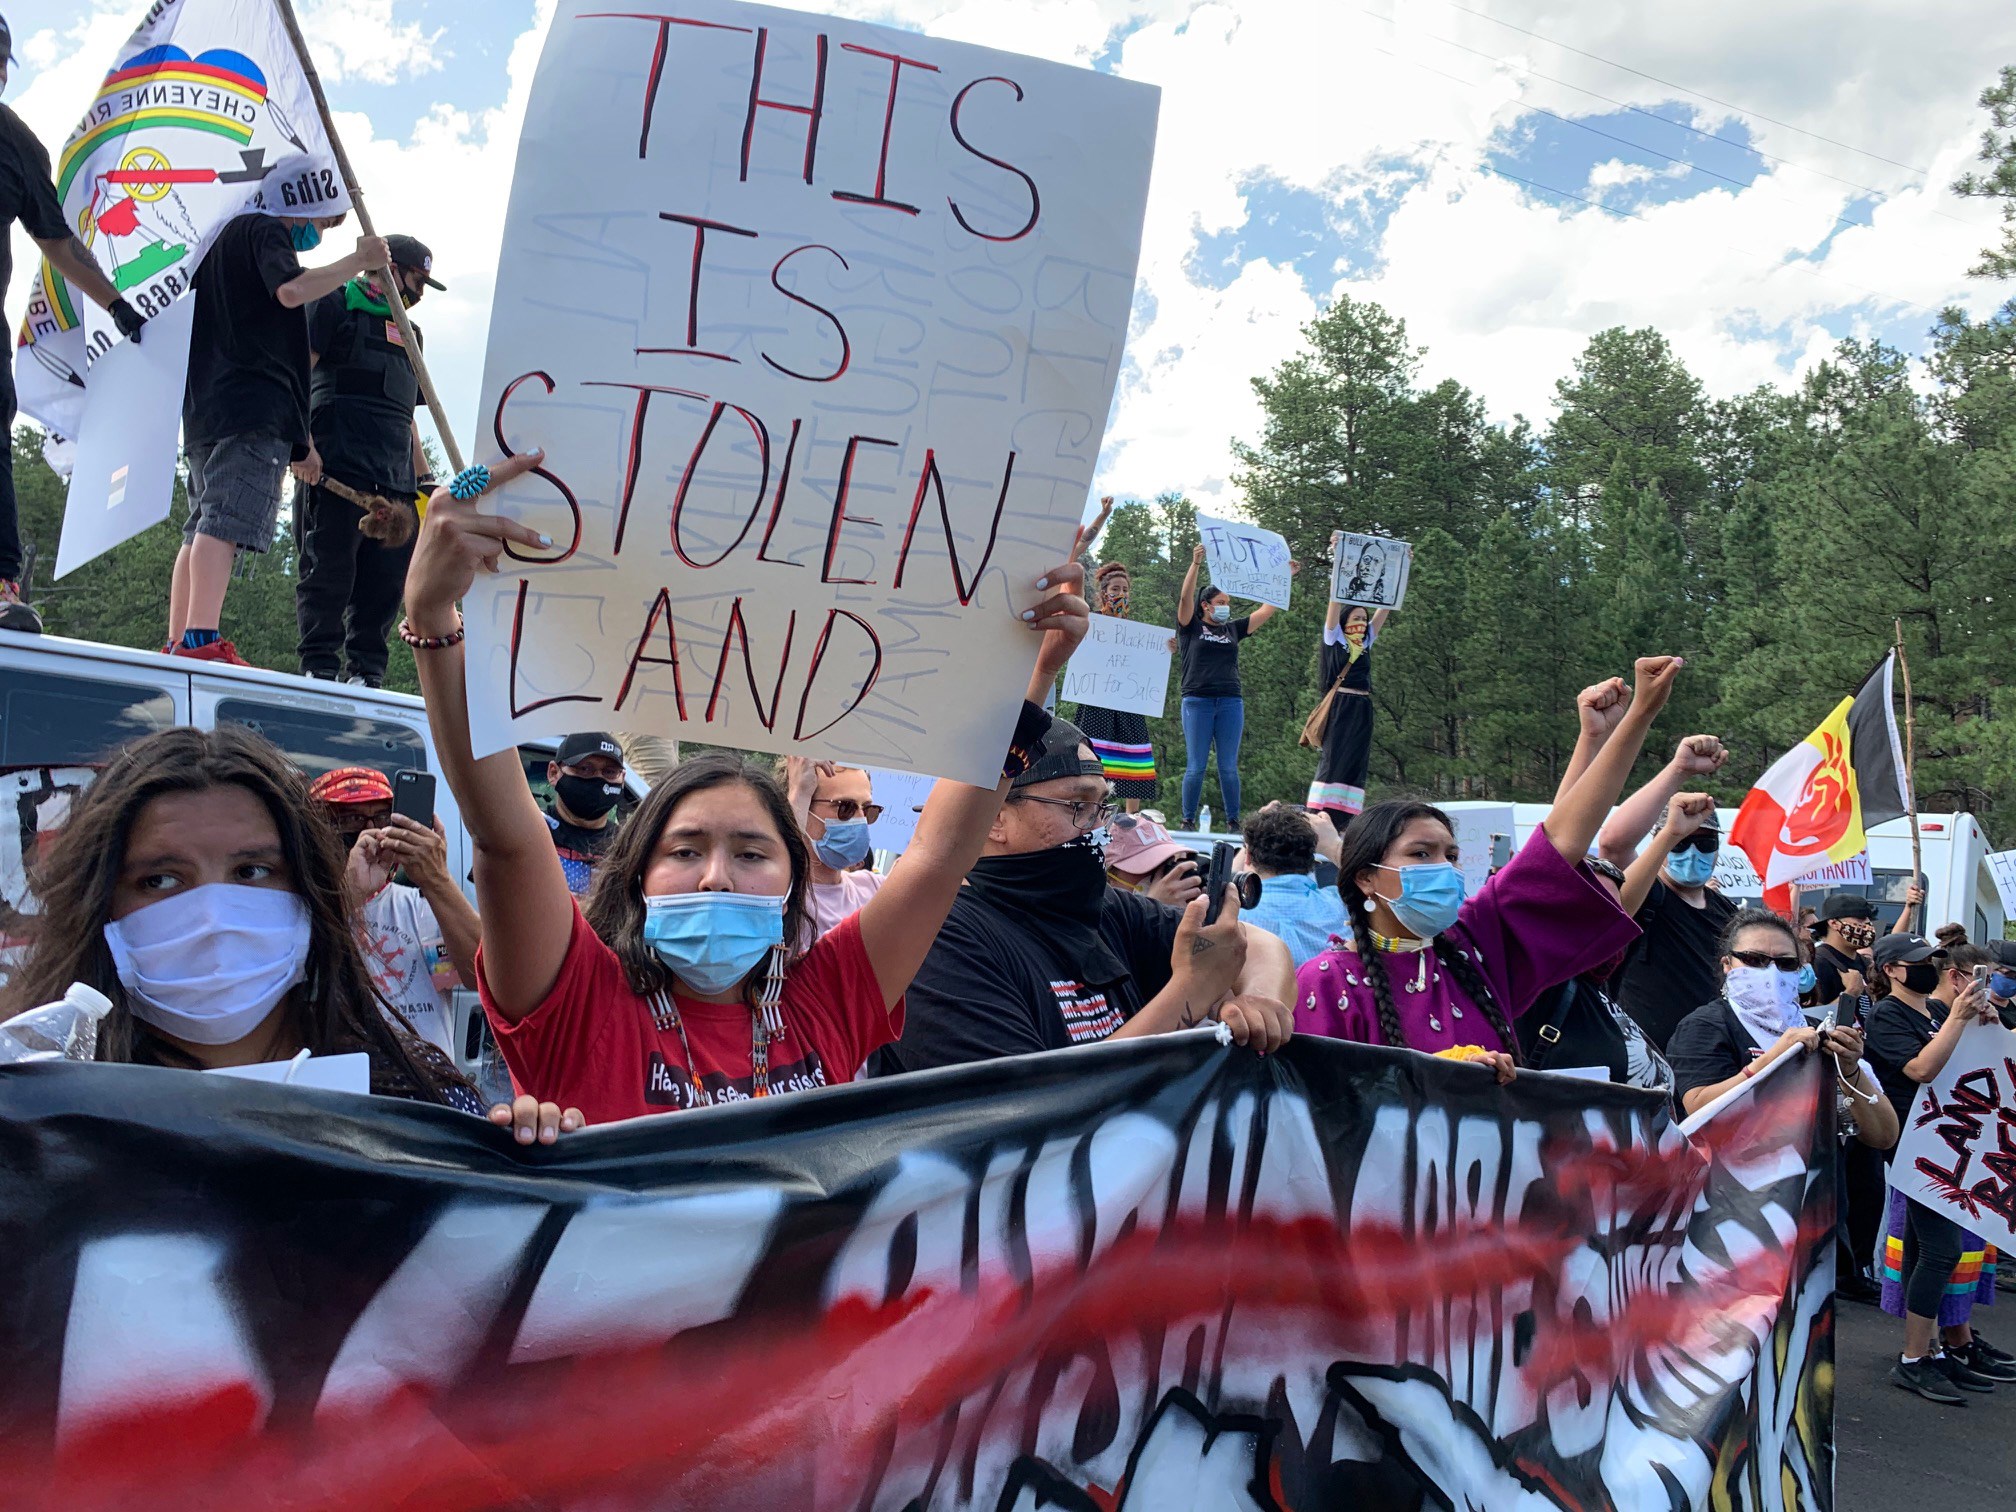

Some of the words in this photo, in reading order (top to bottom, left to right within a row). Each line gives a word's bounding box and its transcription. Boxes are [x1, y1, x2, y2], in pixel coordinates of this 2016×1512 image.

[574, 13, 1041, 243] THIS
[635, 211, 851, 382] IS
[493, 370, 1016, 607] STOLEN
[510, 579, 883, 743] LAND
[1065, 672, 1100, 696] NOT
[1120, 671, 1161, 703] Sale
[1087, 619, 1108, 643] he
[1114, 623, 1145, 649] Black
[1145, 632, 1168, 655] Hills
[1105, 654, 1132, 668] ARE
[1913, 1066, 2001, 1191] LAND
